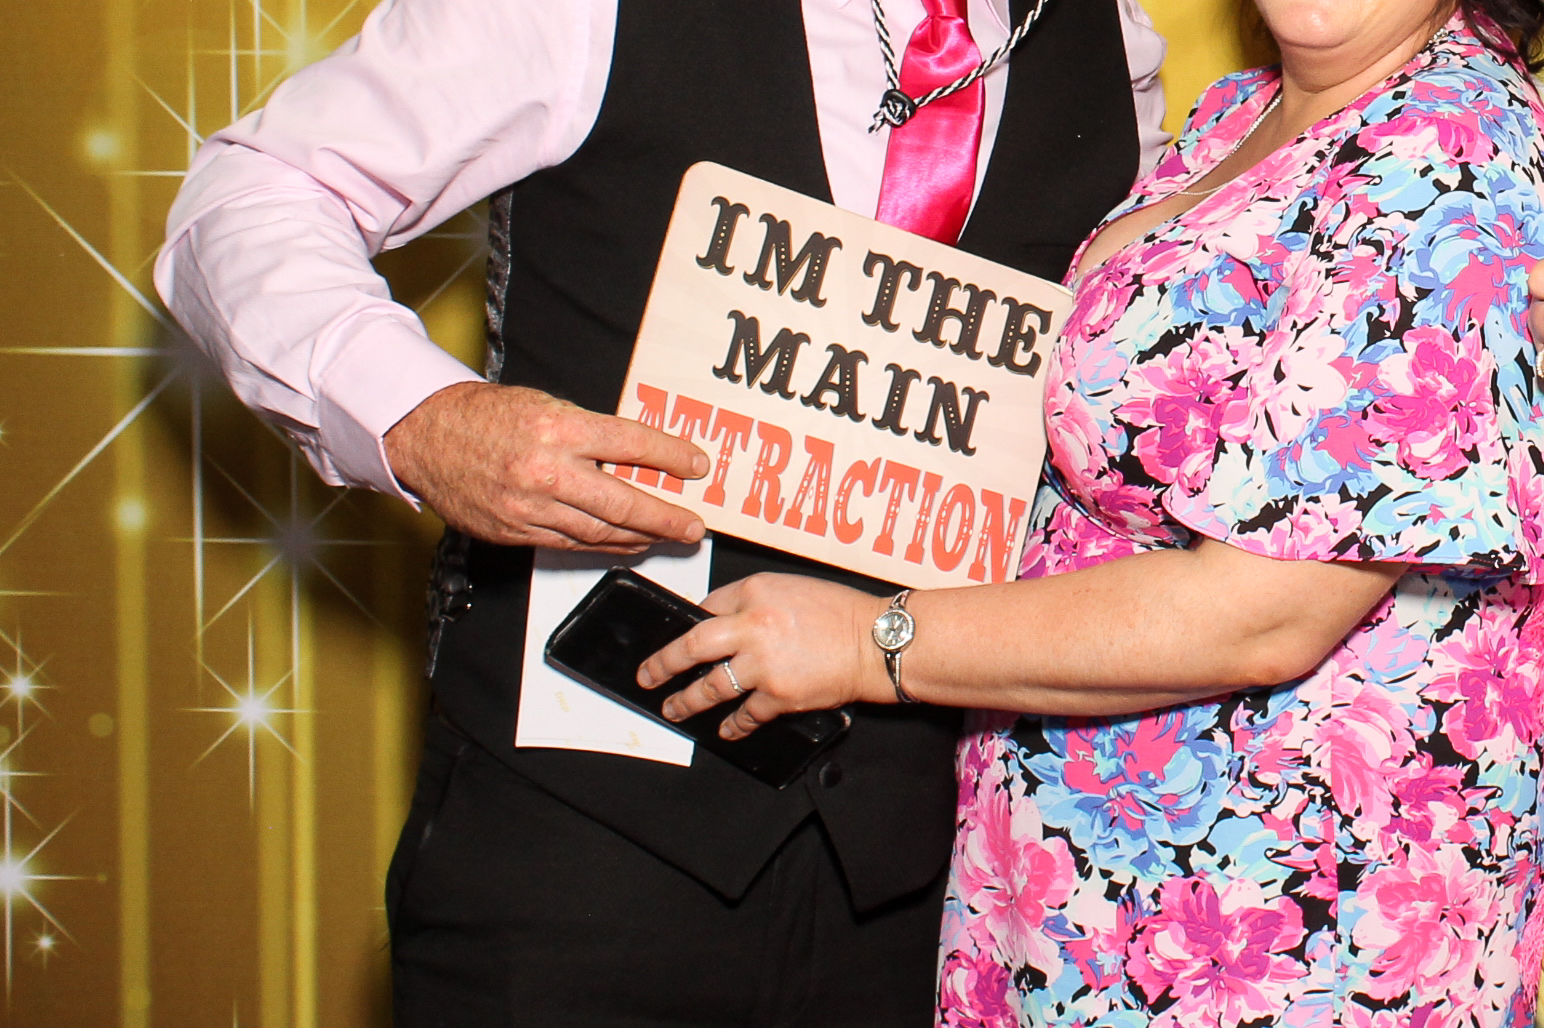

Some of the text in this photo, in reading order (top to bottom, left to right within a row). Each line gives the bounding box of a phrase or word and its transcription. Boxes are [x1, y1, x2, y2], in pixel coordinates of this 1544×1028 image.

[696, 196, 1053, 378] IM THE
[712, 309, 989, 457] MAIN
